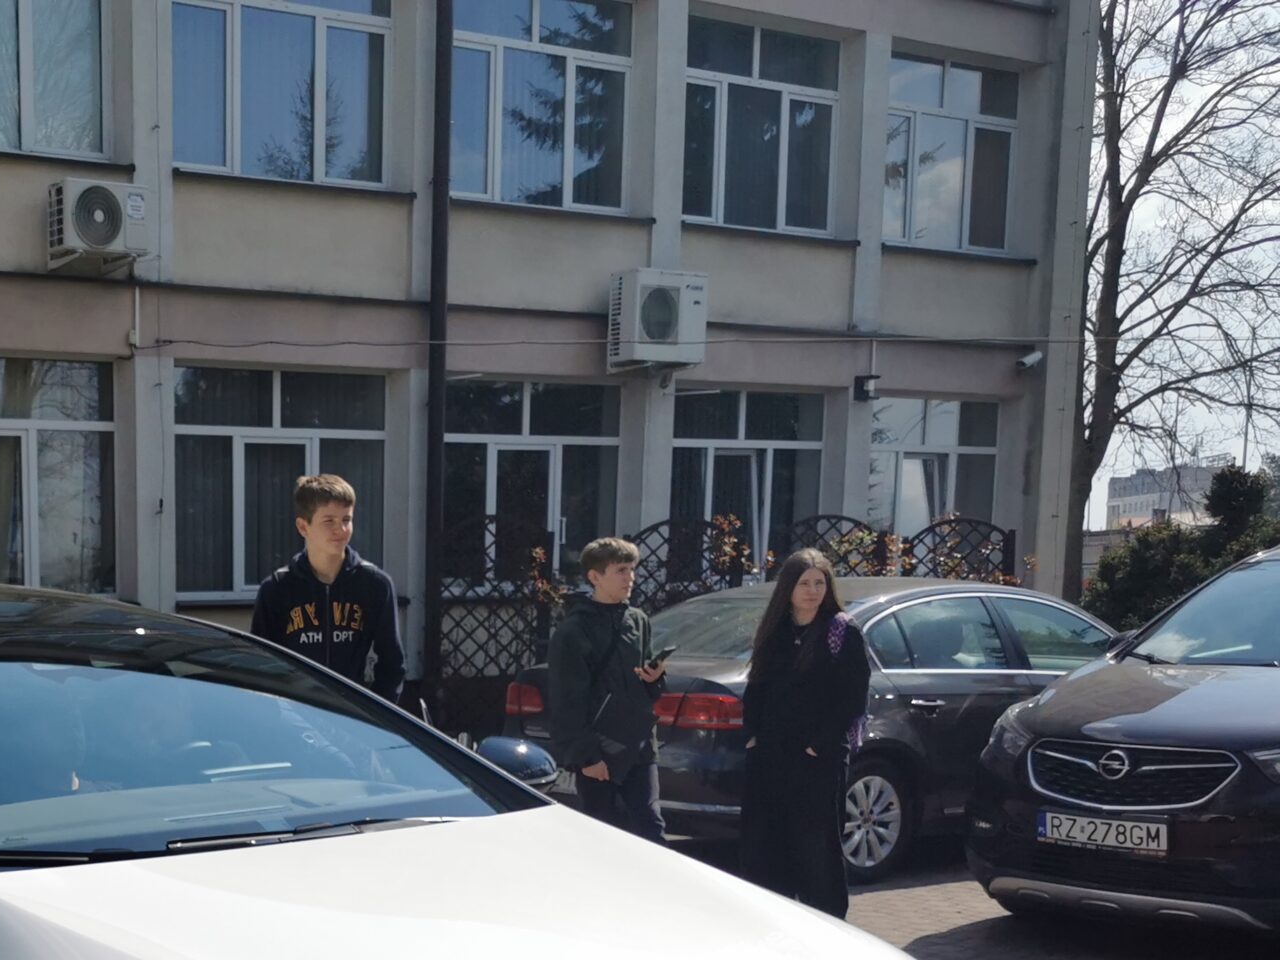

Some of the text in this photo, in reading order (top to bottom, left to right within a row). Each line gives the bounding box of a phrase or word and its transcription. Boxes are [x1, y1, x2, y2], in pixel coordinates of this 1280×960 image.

[300, 631, 355, 644] ATH DPT
[1050, 815, 1078, 840] RZ
[1087, 820, 1161, 849] 278GM
